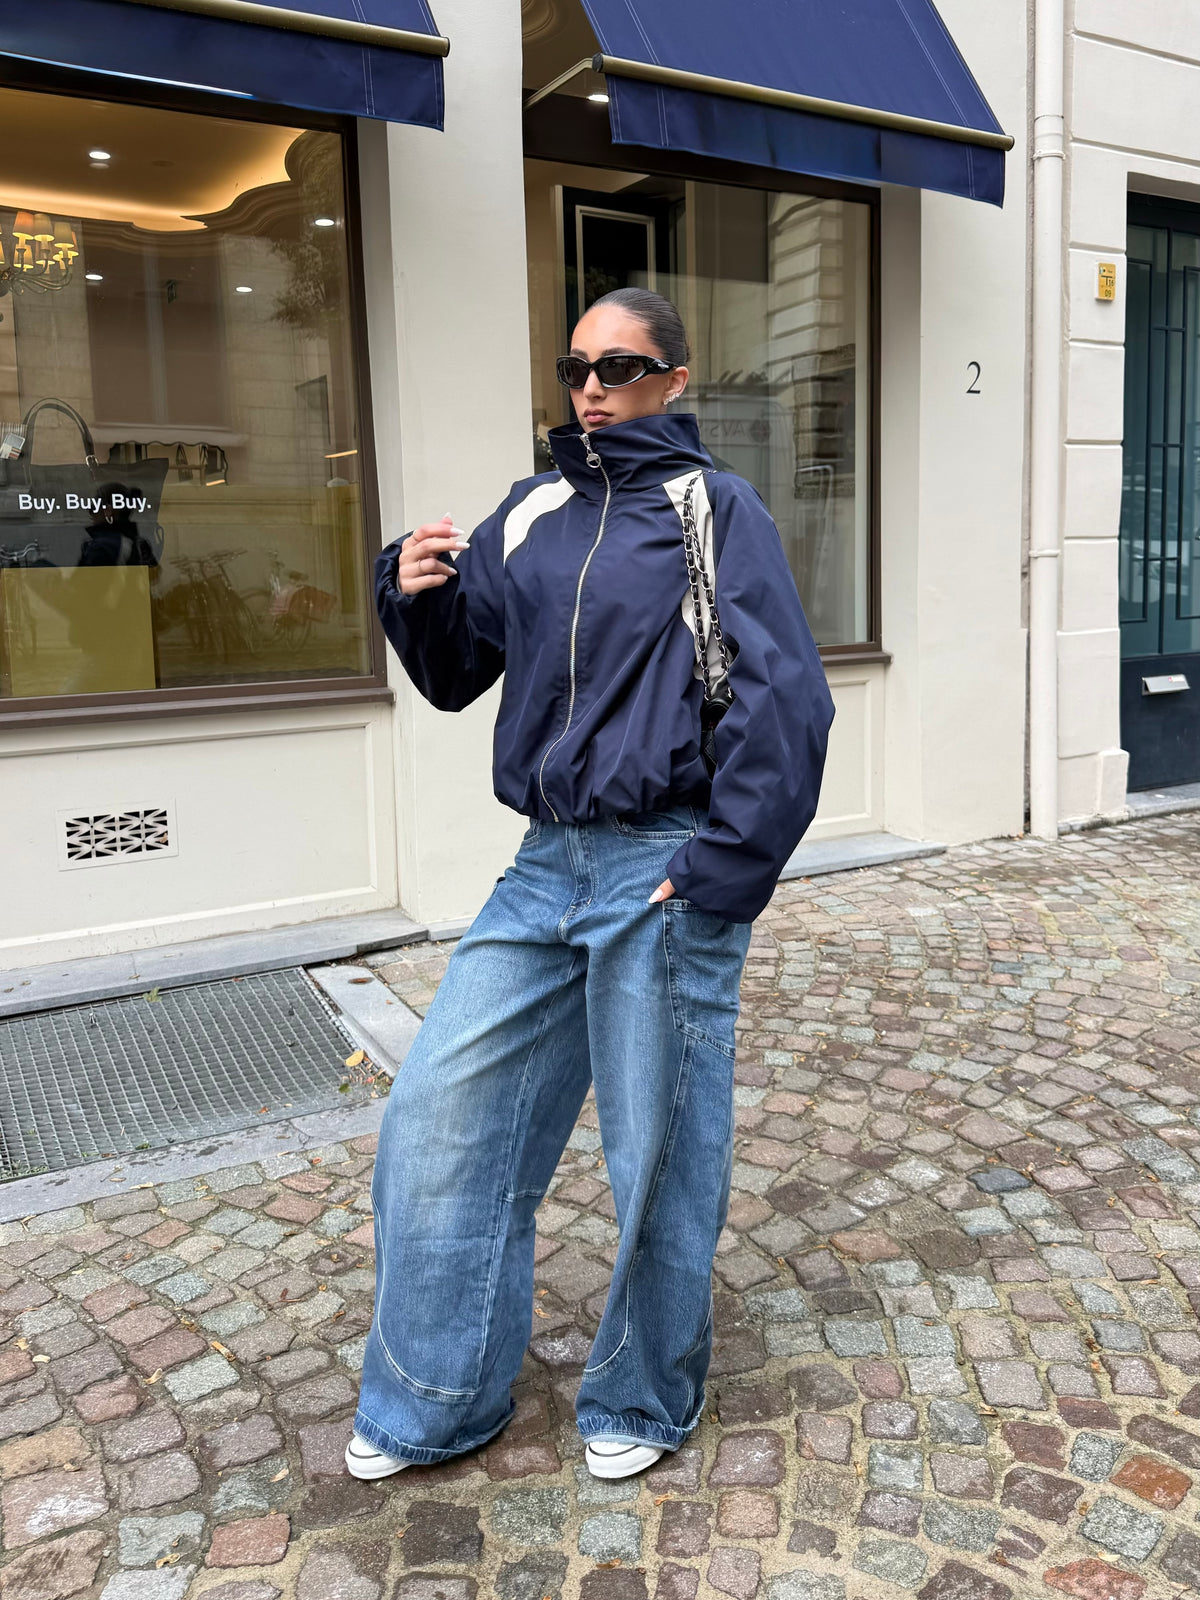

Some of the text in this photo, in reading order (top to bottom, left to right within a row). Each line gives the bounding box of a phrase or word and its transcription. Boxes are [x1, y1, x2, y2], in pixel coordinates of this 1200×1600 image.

[966, 361, 981, 394] 2
[18, 493, 152, 514] Buy. Buy. Buy.
